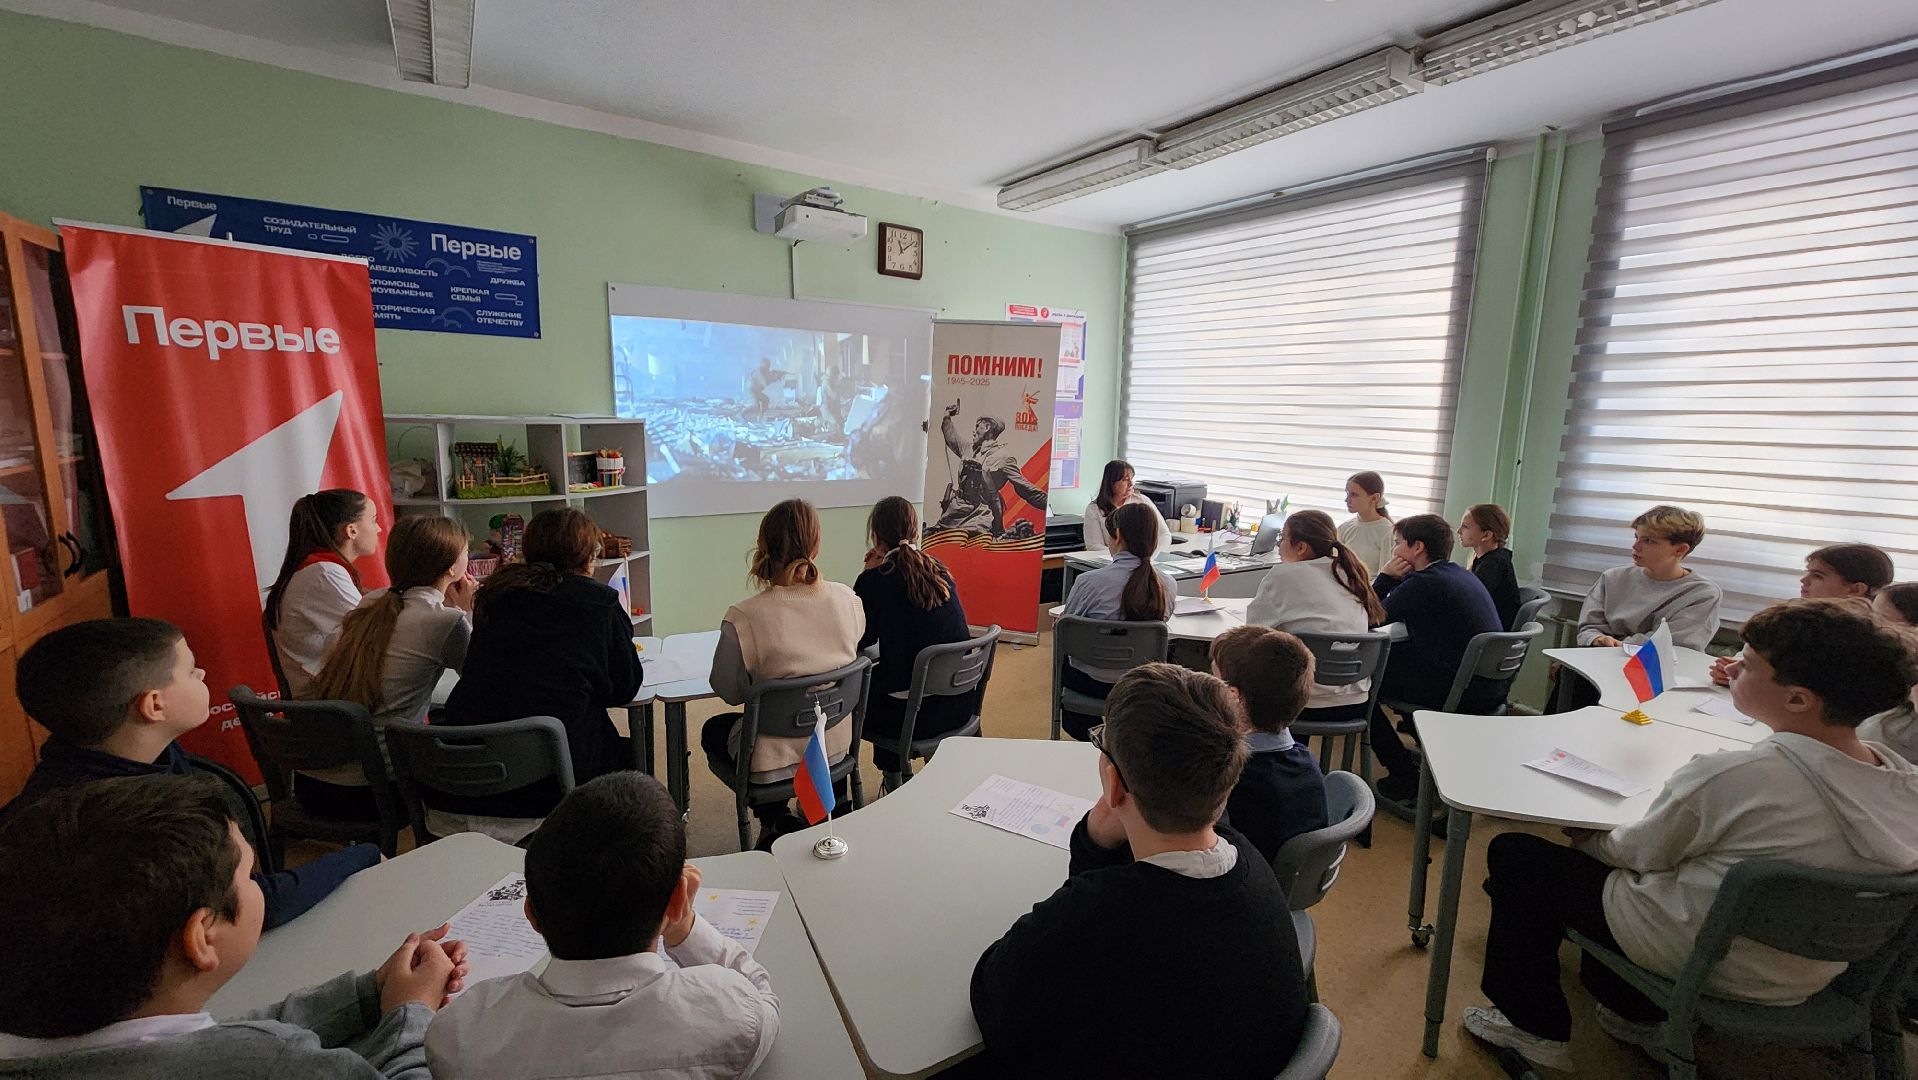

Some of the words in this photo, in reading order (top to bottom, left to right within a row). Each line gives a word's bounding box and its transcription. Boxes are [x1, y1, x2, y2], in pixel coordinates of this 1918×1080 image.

[167, 196, 217, 211] Первые
[263, 215, 357, 234] СОЗИДАТЕЛЬНЫЙ
[264, 225, 292, 235] ТРУД
[431, 233, 522, 260] Первые
[369, 264, 439, 277] АВЕДЛИВОСТЬ
[369, 278, 420, 289] ОПОМОЩЬ
[490, 277, 526, 287] ДРУЖБА
[370, 286, 434, 298] МОУВАЖЕНИЕ
[450, 286, 490, 296] КРЕПКАЯ
[450, 294, 481, 303] СЕМЬЯ
[372, 304, 436, 315] ТОРИЧЕСКАЯ
[476, 309, 522, 319] СЛУЖЕНИЕ
[476, 316, 524, 327] ОТЕЧЕСТВУ
[122, 304, 341, 361] Первые
[947, 354, 1043, 379] ПОМНИМ!
